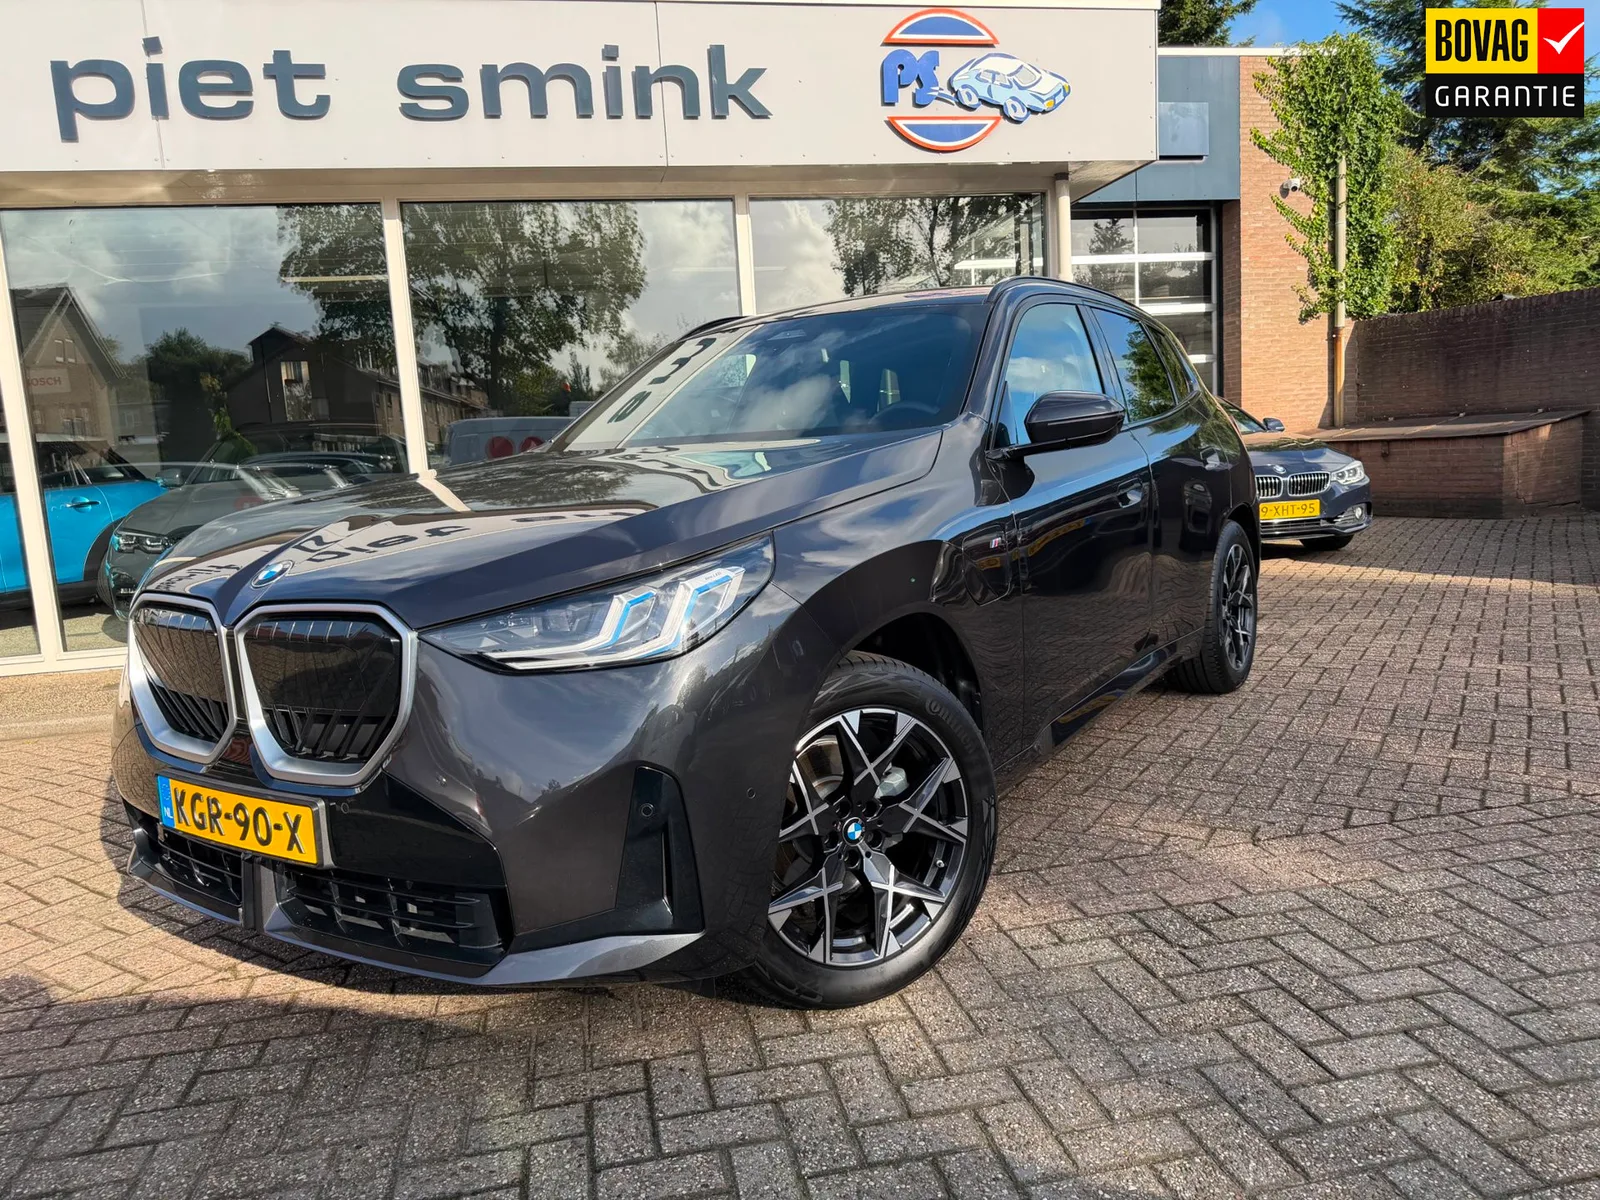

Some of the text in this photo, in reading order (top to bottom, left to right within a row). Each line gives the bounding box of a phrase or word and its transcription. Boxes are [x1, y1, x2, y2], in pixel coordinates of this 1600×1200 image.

[50, 37, 772, 143] piet smink
[1261, 503, 1315, 517] 9-XHT-95
[174, 787, 305, 854] KGR-90-X
